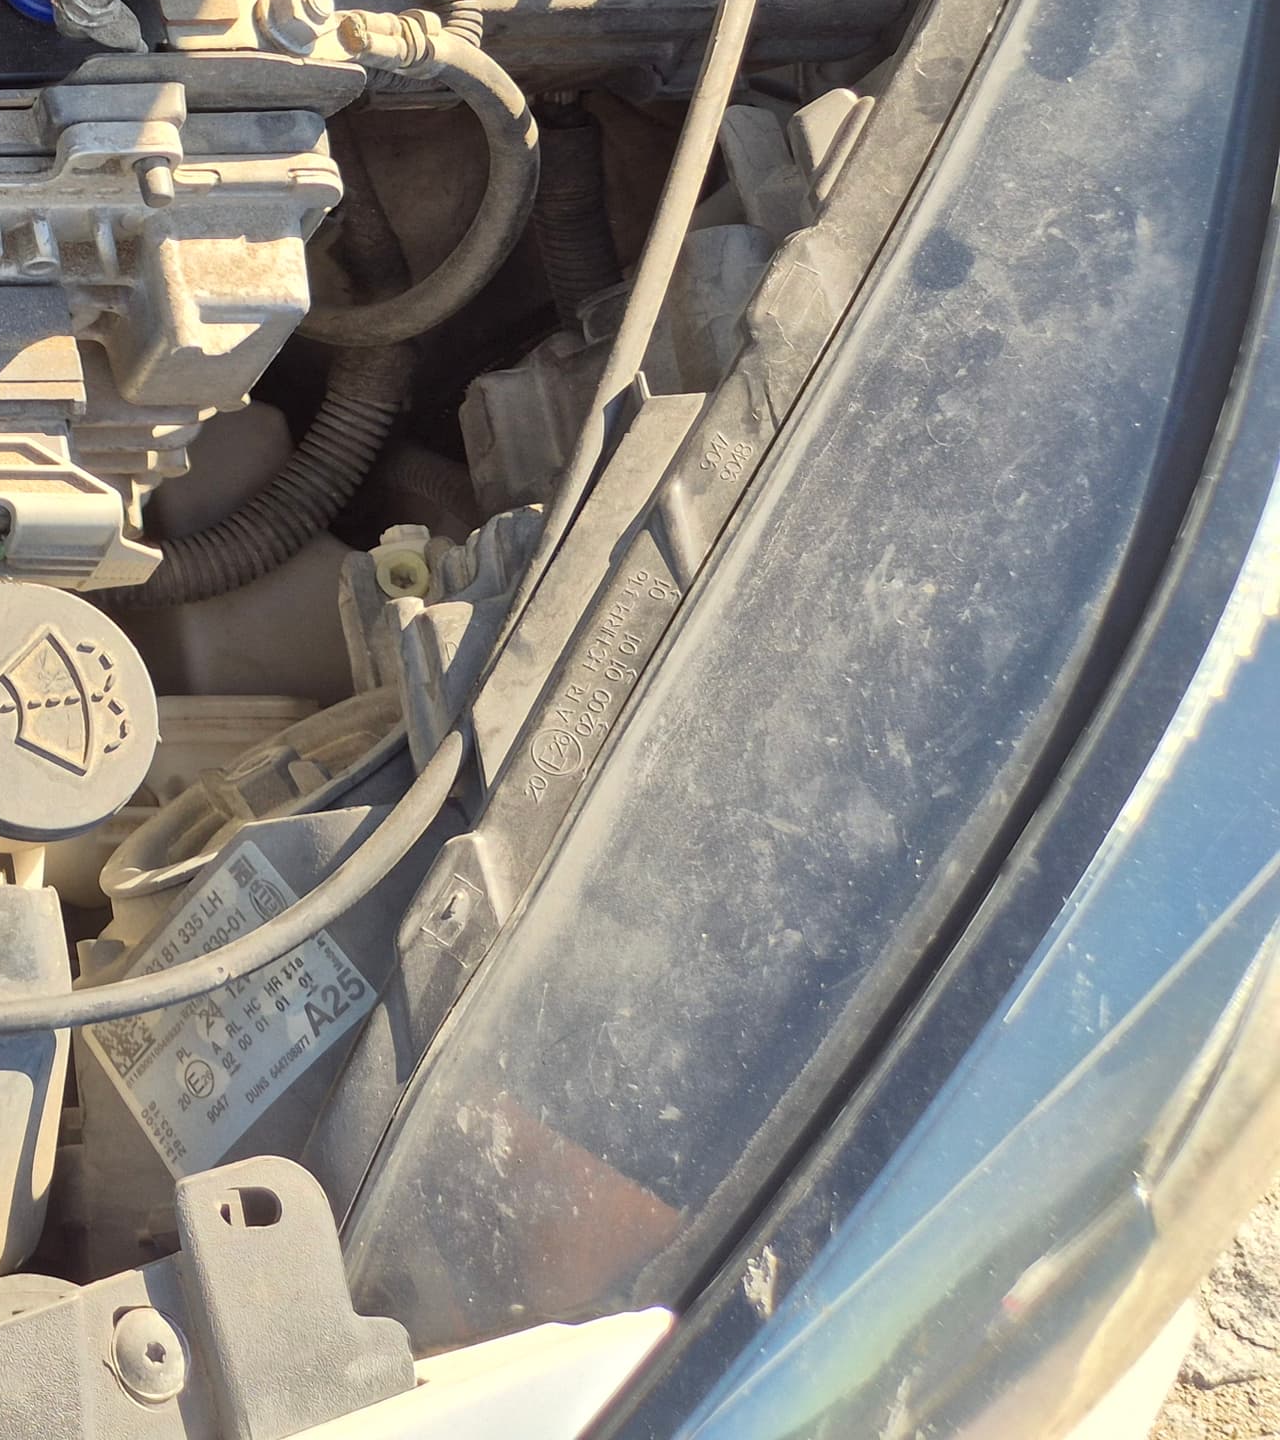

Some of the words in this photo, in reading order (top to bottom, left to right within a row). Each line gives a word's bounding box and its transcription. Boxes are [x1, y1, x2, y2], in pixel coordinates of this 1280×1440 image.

[575, 712, 595, 738] 02
[588, 689, 612, 714] 00
[605, 658, 628, 682] 01
[619, 631, 642, 656] 01
[648, 577, 672, 601] 01
[525, 775, 548, 804] 20
[565, 683, 590, 703] RL
[583, 646, 608, 672] HC
[161, 940, 180, 963] 81
[178, 911, 204, 944] 335
[200, 890, 224, 917] LH
[212, 1041, 222, 1055] A
[225, 1021, 243, 1038] RL
[243, 997, 261, 1018] HC
[263, 976, 283, 997] HR
[303, 967, 365, 1038] A25
[176, 1047, 192, 1064] PL
[178, 1093, 191, 1112] 20
[222, 1052, 237, 1070] 02
[238, 1033, 252, 1051] 00
[255, 1015, 270, 1033] 01
[275, 995, 290, 1012] 01
[298, 971, 313, 989] 01
[207, 1093, 229, 1122] 9047
[245, 1076, 270, 1104] DUNS
